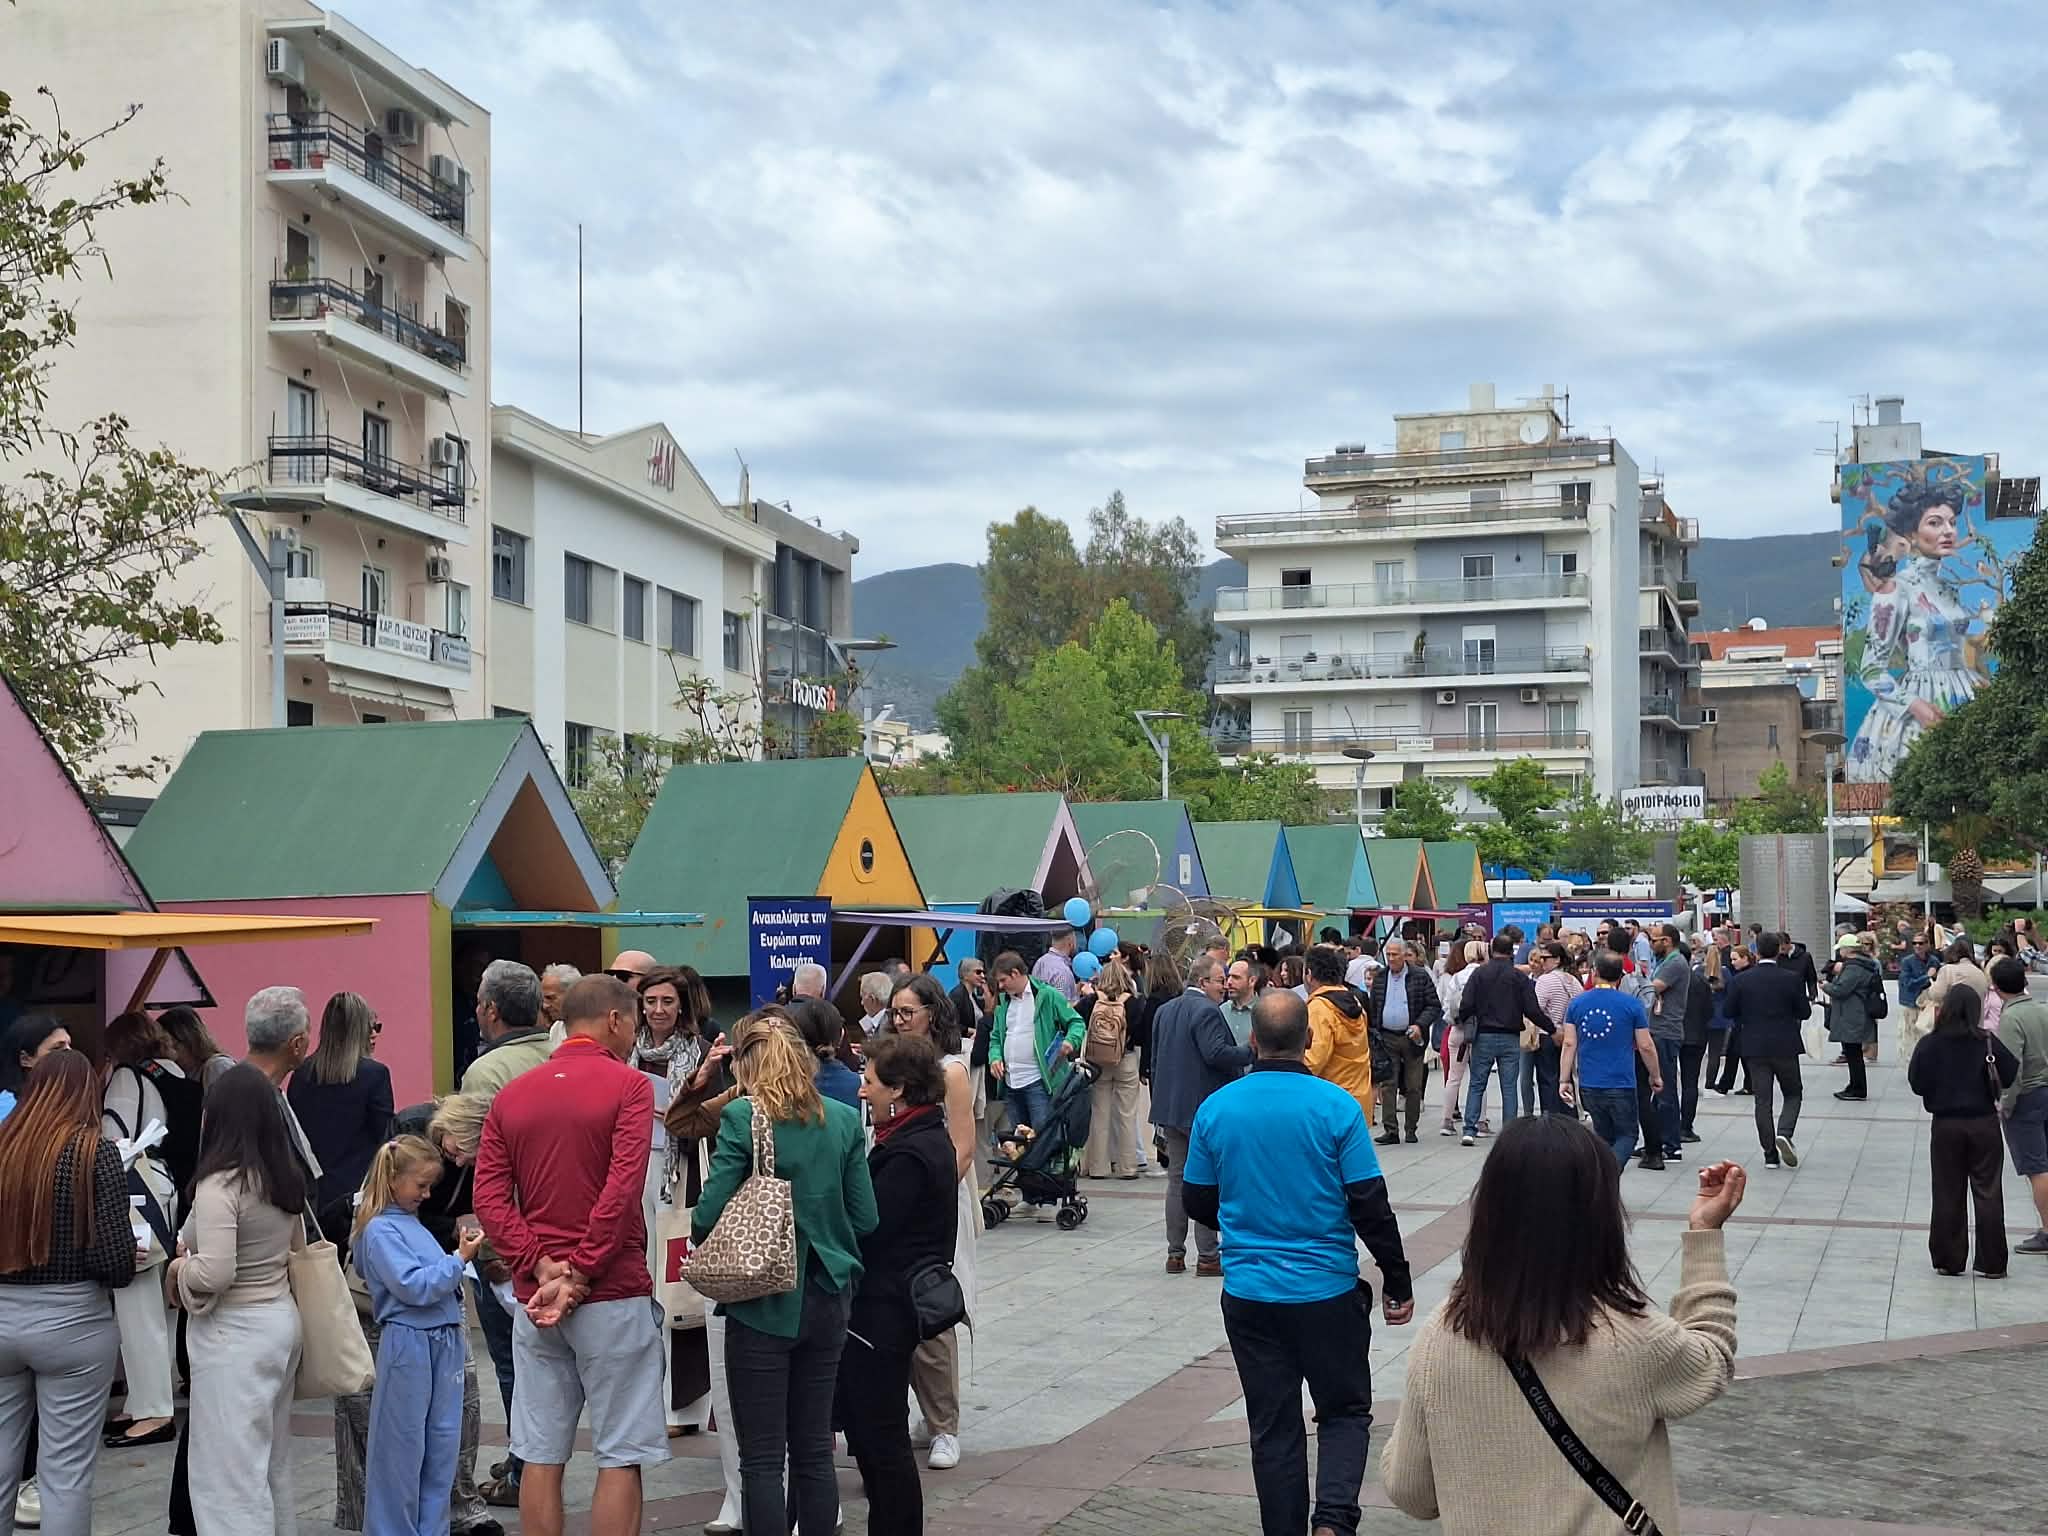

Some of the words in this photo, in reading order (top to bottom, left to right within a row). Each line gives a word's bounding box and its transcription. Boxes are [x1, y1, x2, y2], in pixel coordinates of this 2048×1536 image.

[792, 678, 827, 710] notos
[1624, 793, 1701, 809] ΦΩΤΟΓΡΑΦΕΙΟ
[752, 908, 809, 927] Ανακαλύψτε
[811, 912, 826, 924] την
[760, 931, 797, 950] Ευρώπη
[800, 935, 821, 945] στην
[1528, 1386, 1559, 1428] GUESS
[1560, 1434, 1592, 1472] GUESS
[1596, 1476, 1627, 1509] GUESS
